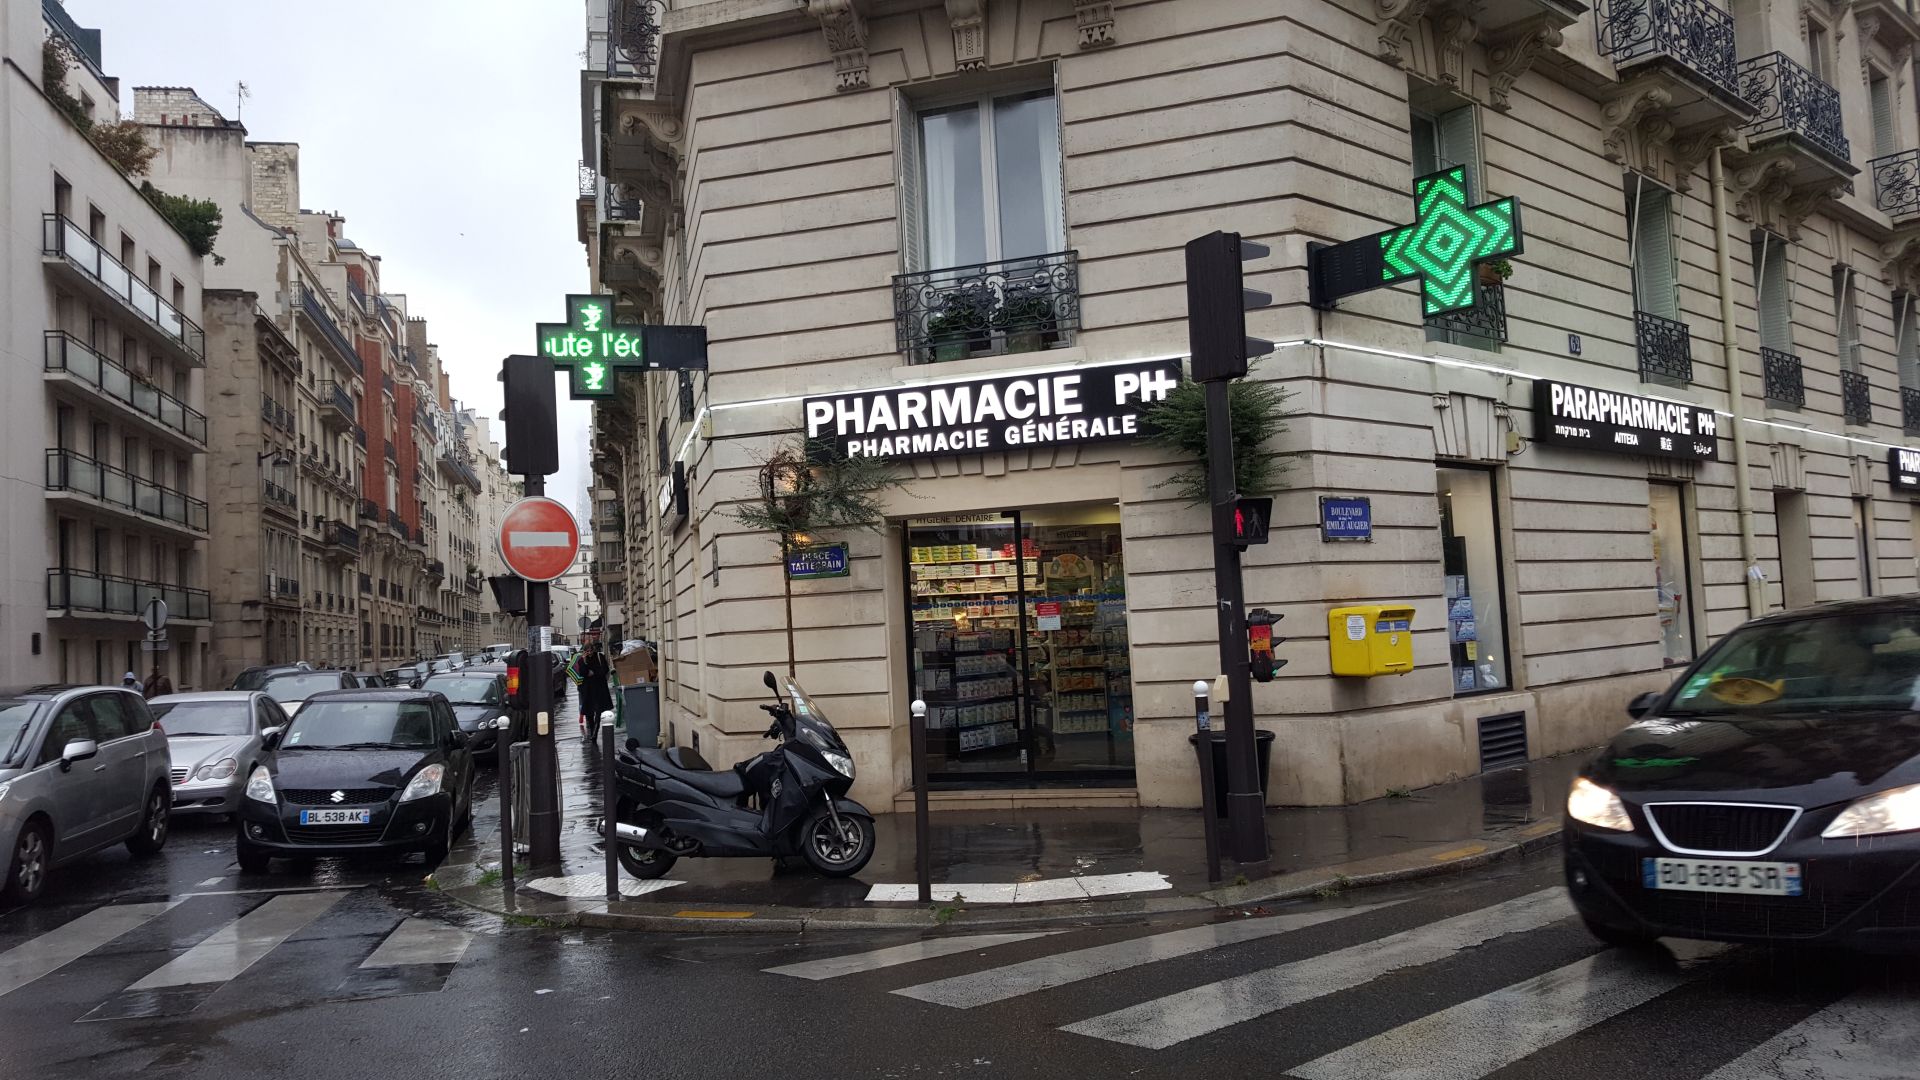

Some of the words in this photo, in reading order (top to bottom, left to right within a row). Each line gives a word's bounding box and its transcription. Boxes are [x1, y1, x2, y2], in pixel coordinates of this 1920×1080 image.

[1570, 336, 1580, 352] 62
[807, 374, 1083, 438] PHARMACIE
[1551, 383, 1691, 435] PARAPHARMACIE
[847, 428, 989, 459] PHARMACIE
[1005, 414, 1137, 444] GÉNÉRALE
[1899, 450, 1920, 473] PHAR
[956, 513, 994, 523] DENTAIRE
[1330, 507, 1363, 516] BOULEVARD
